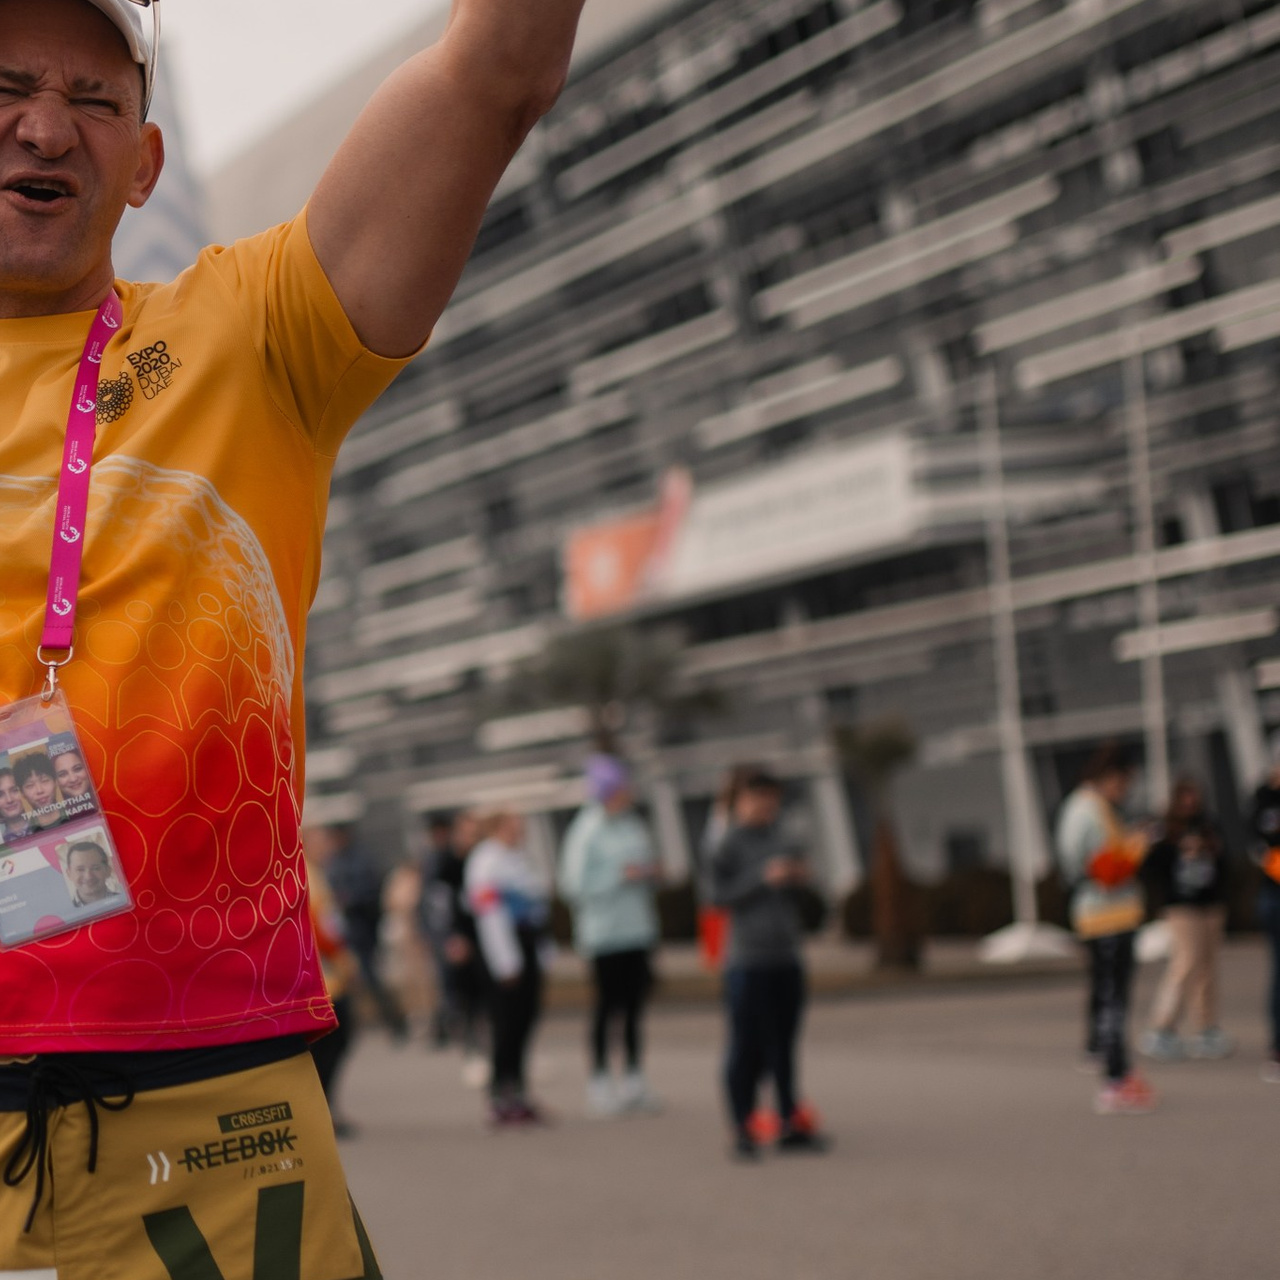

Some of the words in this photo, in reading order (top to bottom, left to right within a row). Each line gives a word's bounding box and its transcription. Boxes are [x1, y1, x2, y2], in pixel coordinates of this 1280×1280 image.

[126, 340, 167, 366] EXPO
[133, 353, 171, 378] 2020
[138, 358, 183, 390] DUBAI
[142, 378, 174, 400] UAE
[21, 792, 91, 821] ТРАНСПОРТНАЯ
[65, 802, 95, 817] КАРТА
